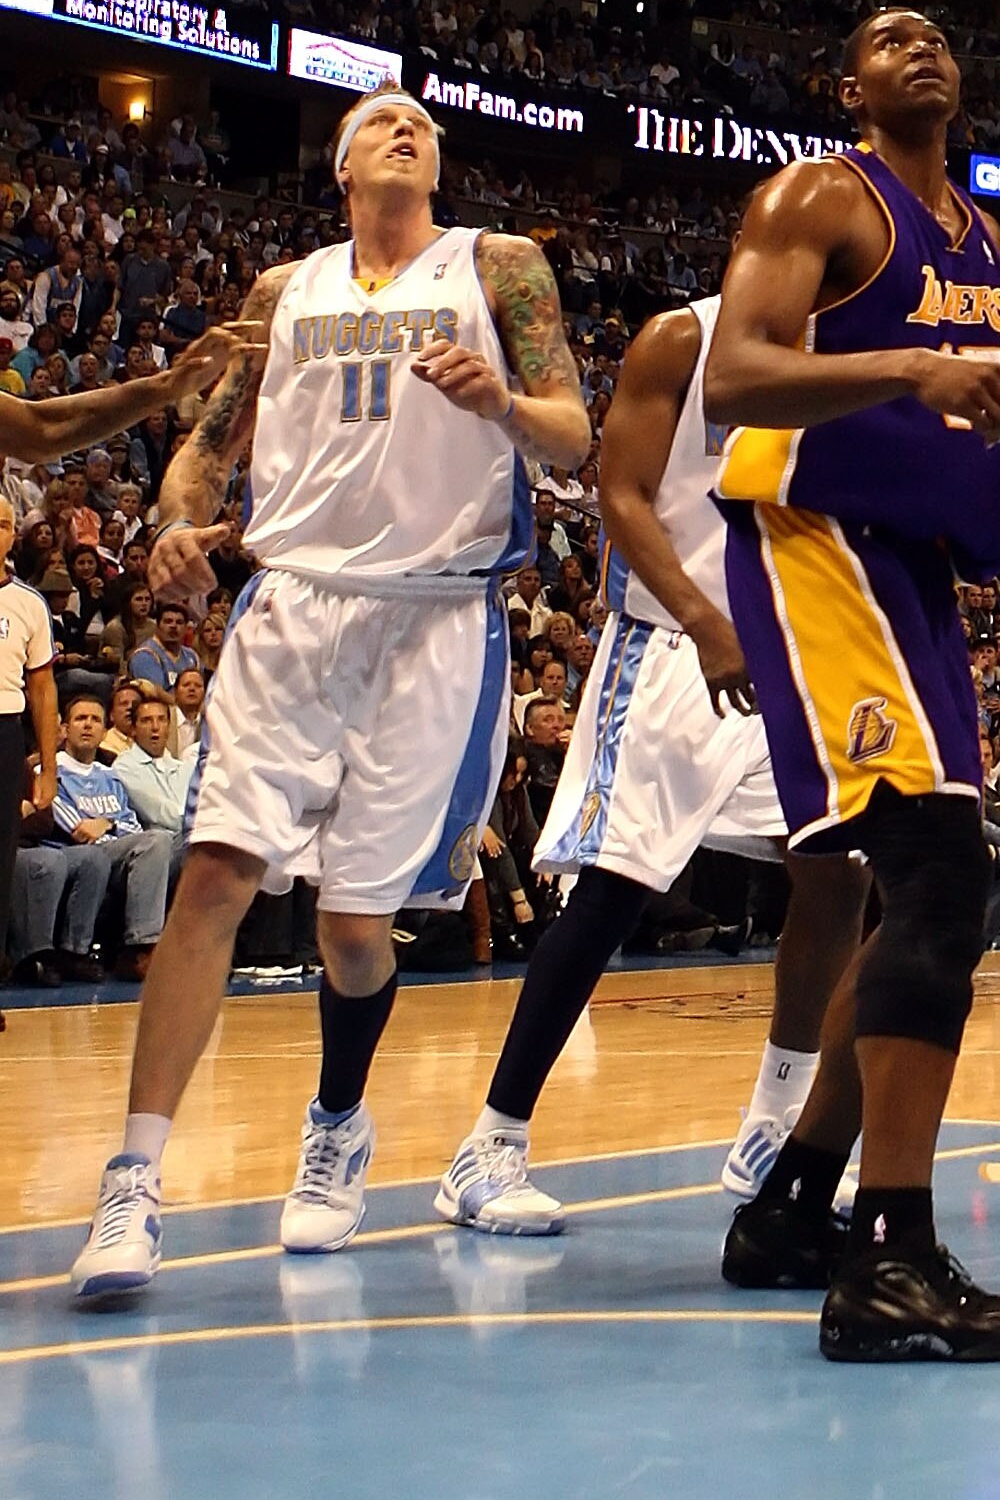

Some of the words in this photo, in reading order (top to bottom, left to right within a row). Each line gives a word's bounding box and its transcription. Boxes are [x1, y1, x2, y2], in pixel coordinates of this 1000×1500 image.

[178, 20, 260, 60] Solutions
[214, 7, 227, 32] &
[422, 72, 584, 132] AmFam.com
[627, 104, 704, 157] THE
[293, 308, 458, 365] NUGGETS
[341, 360, 392, 423] 11
